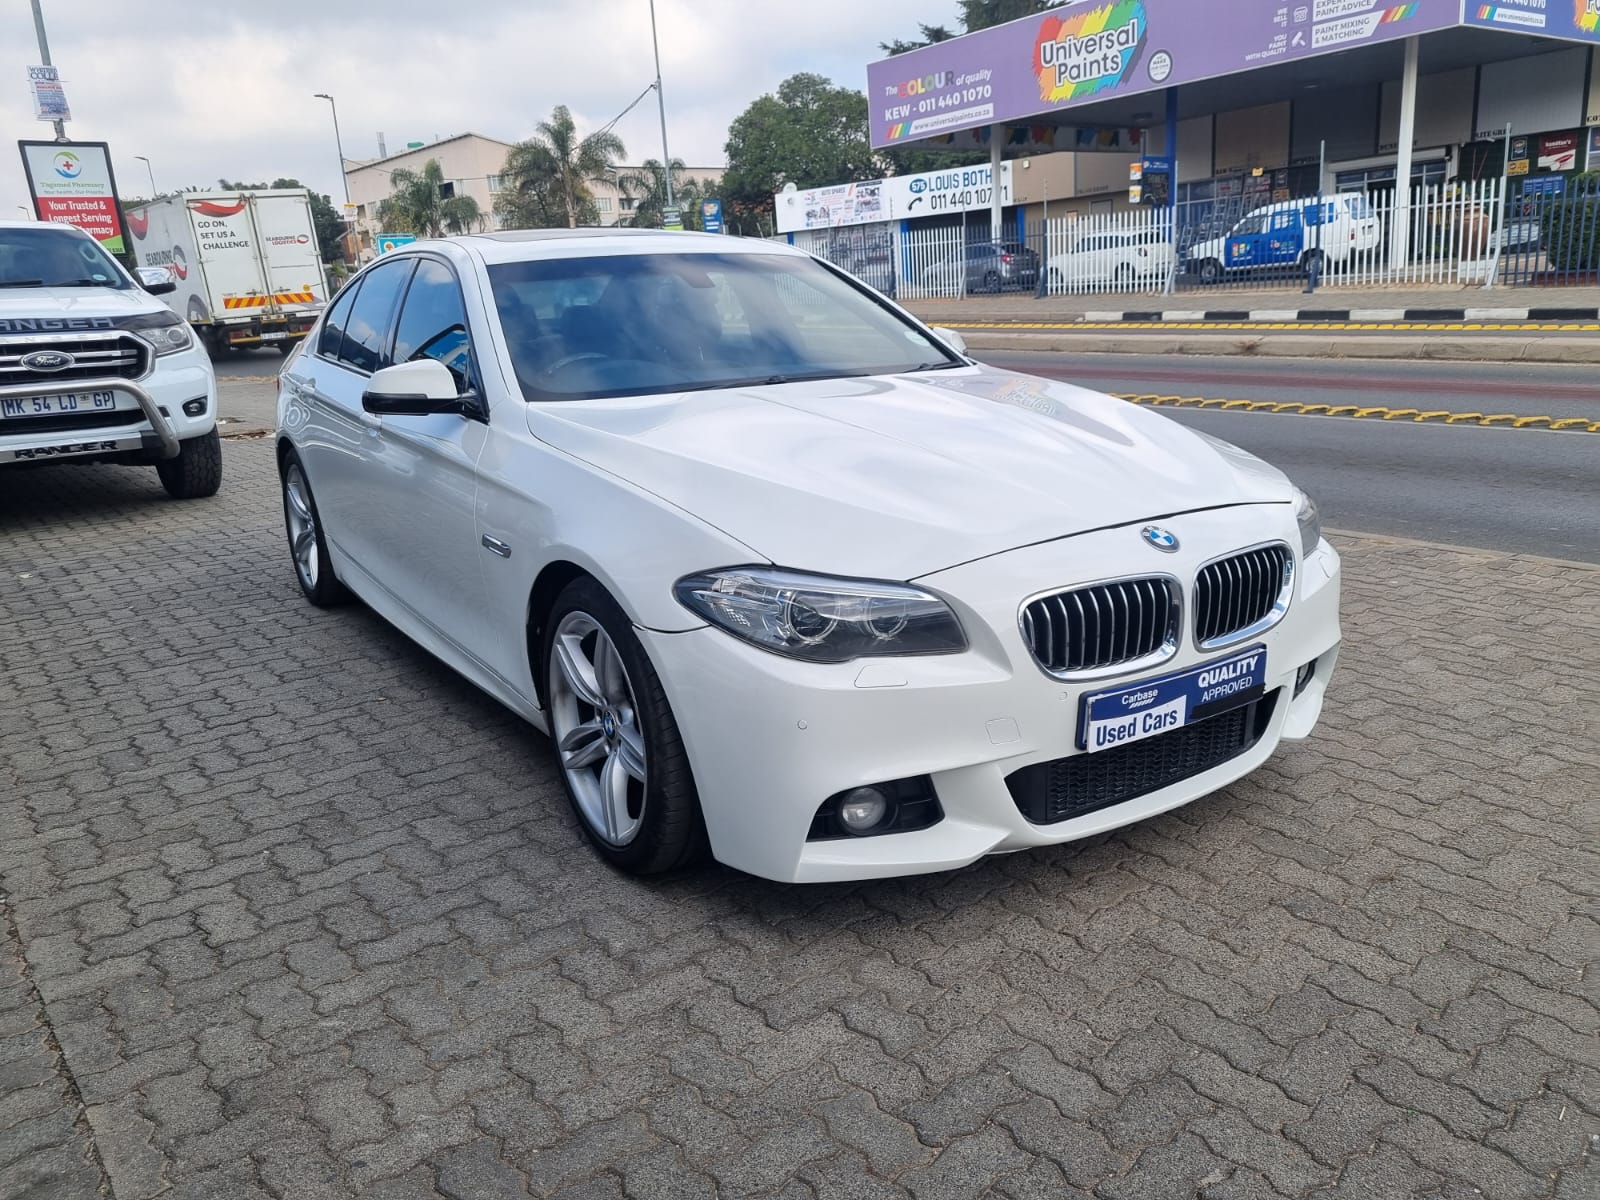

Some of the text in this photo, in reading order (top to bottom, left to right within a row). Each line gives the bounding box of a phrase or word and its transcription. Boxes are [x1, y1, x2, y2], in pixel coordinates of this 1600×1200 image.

[1315, 6, 1340, 17] PAINT
[1315, 17, 1370, 36] PAINT MIXING
[1322, 28, 1364, 42] MATCHING
[1042, 20, 1136, 65] Universal
[1057, 52, 1120, 84] Paints
[885, 69, 993, 97] The COLOUR of quality
[885, 103, 911, 122] KEW
[919, 98, 936, 113] 011
[938, 92, 960, 109] 440
[962, 84, 992, 103] 1070
[928, 173, 960, 192] LOUIS
[48, 201, 107, 210] Your Trusted &
[931, 193, 947, 210] 011
[950, 190, 972, 208] 440
[48, 213, 112, 224] Longest Serving
[212, 220, 228, 228] ON,
[200, 232, 215, 240] SET
[217, 231, 228, 239] US
[203, 240, 249, 250] CHALLENGE
[35, 355, 62, 366] Ford
[6, 391, 111, 415] MK 54 LD GP
[15, 440, 118, 459] RANGER
[1198, 655, 1259, 688] QUALITY
[1121, 688, 1158, 705] Carbase
[1201, 676, 1253, 703] APPROVED
[1096, 709, 1178, 747] Used Cars
